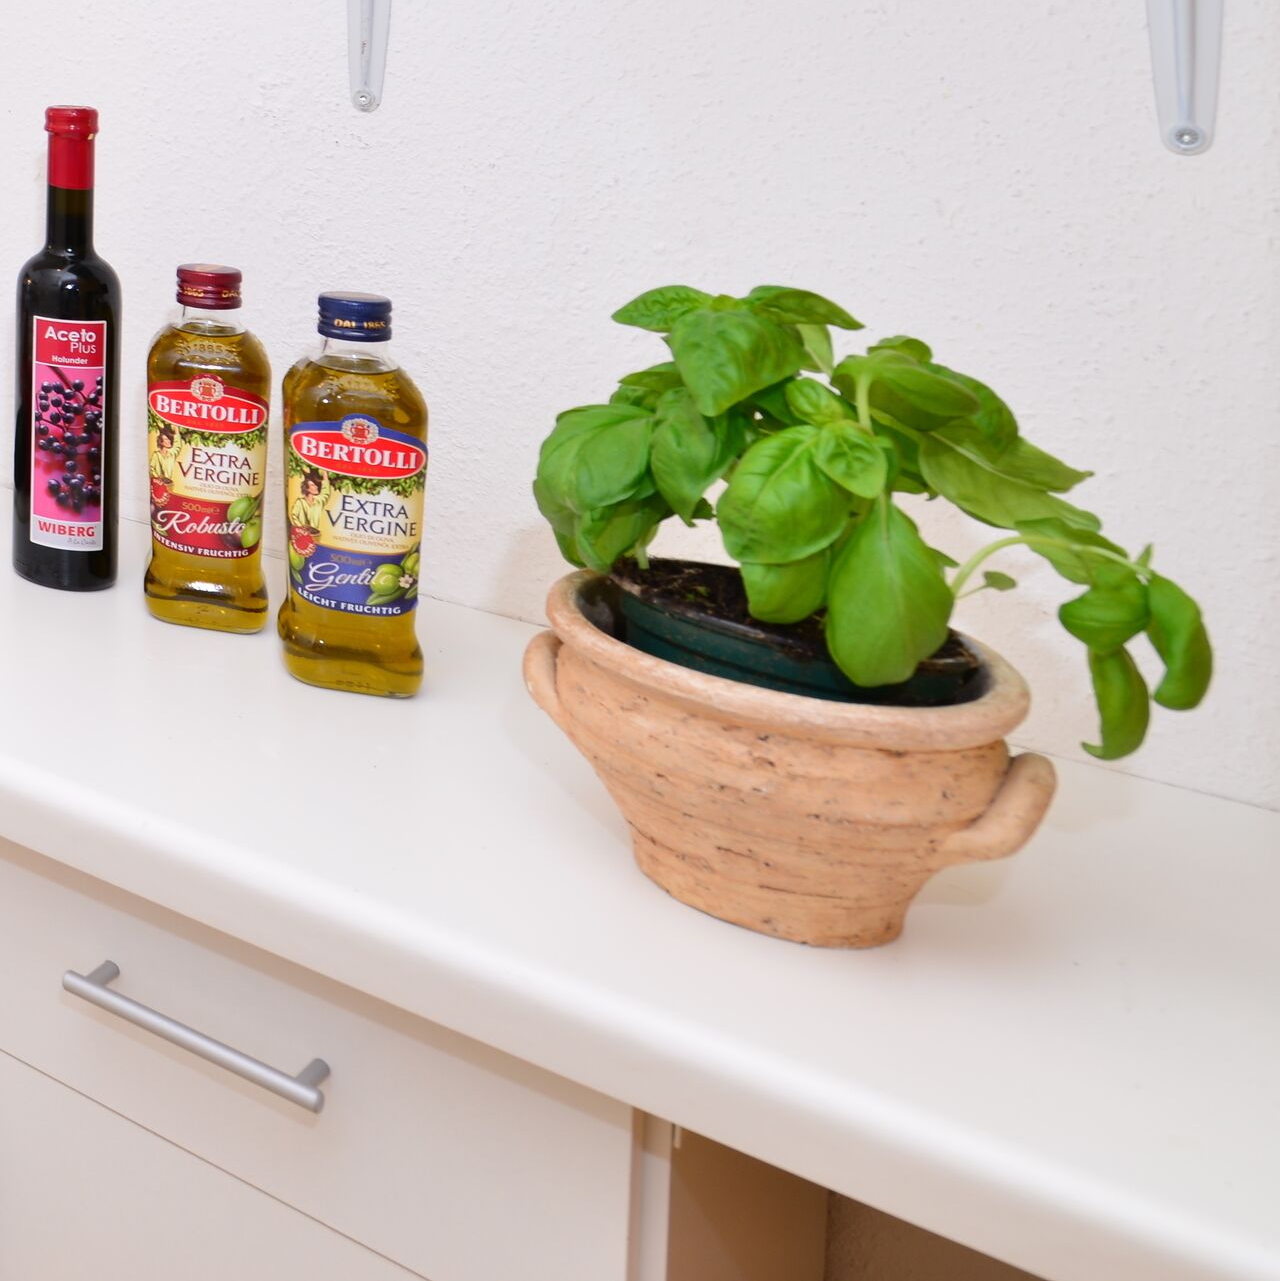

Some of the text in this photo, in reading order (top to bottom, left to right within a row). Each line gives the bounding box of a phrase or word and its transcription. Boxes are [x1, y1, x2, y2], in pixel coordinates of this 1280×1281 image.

[44, 325, 97, 342] Aceto
[51, 354, 89, 365] Holunder
[70, 341, 97, 354] Plus
[155, 395, 259, 424] BERTOLLI
[191, 447, 252, 470] EXTRA
[300, 436, 416, 469] BERTOLLI
[177, 461, 260, 487] VERGINE
[341, 494, 409, 519] EXTRA
[38, 520, 96, 537] WIBERG
[156, 509, 247, 535] Robusto
[326, 509, 417, 537] VERGINE
[153, 530, 249, 557] INTENSIV FRUCHTIG
[304, 561, 390, 592] Gentile
[297, 586, 401, 615] LEICHT FRUCHTIG
